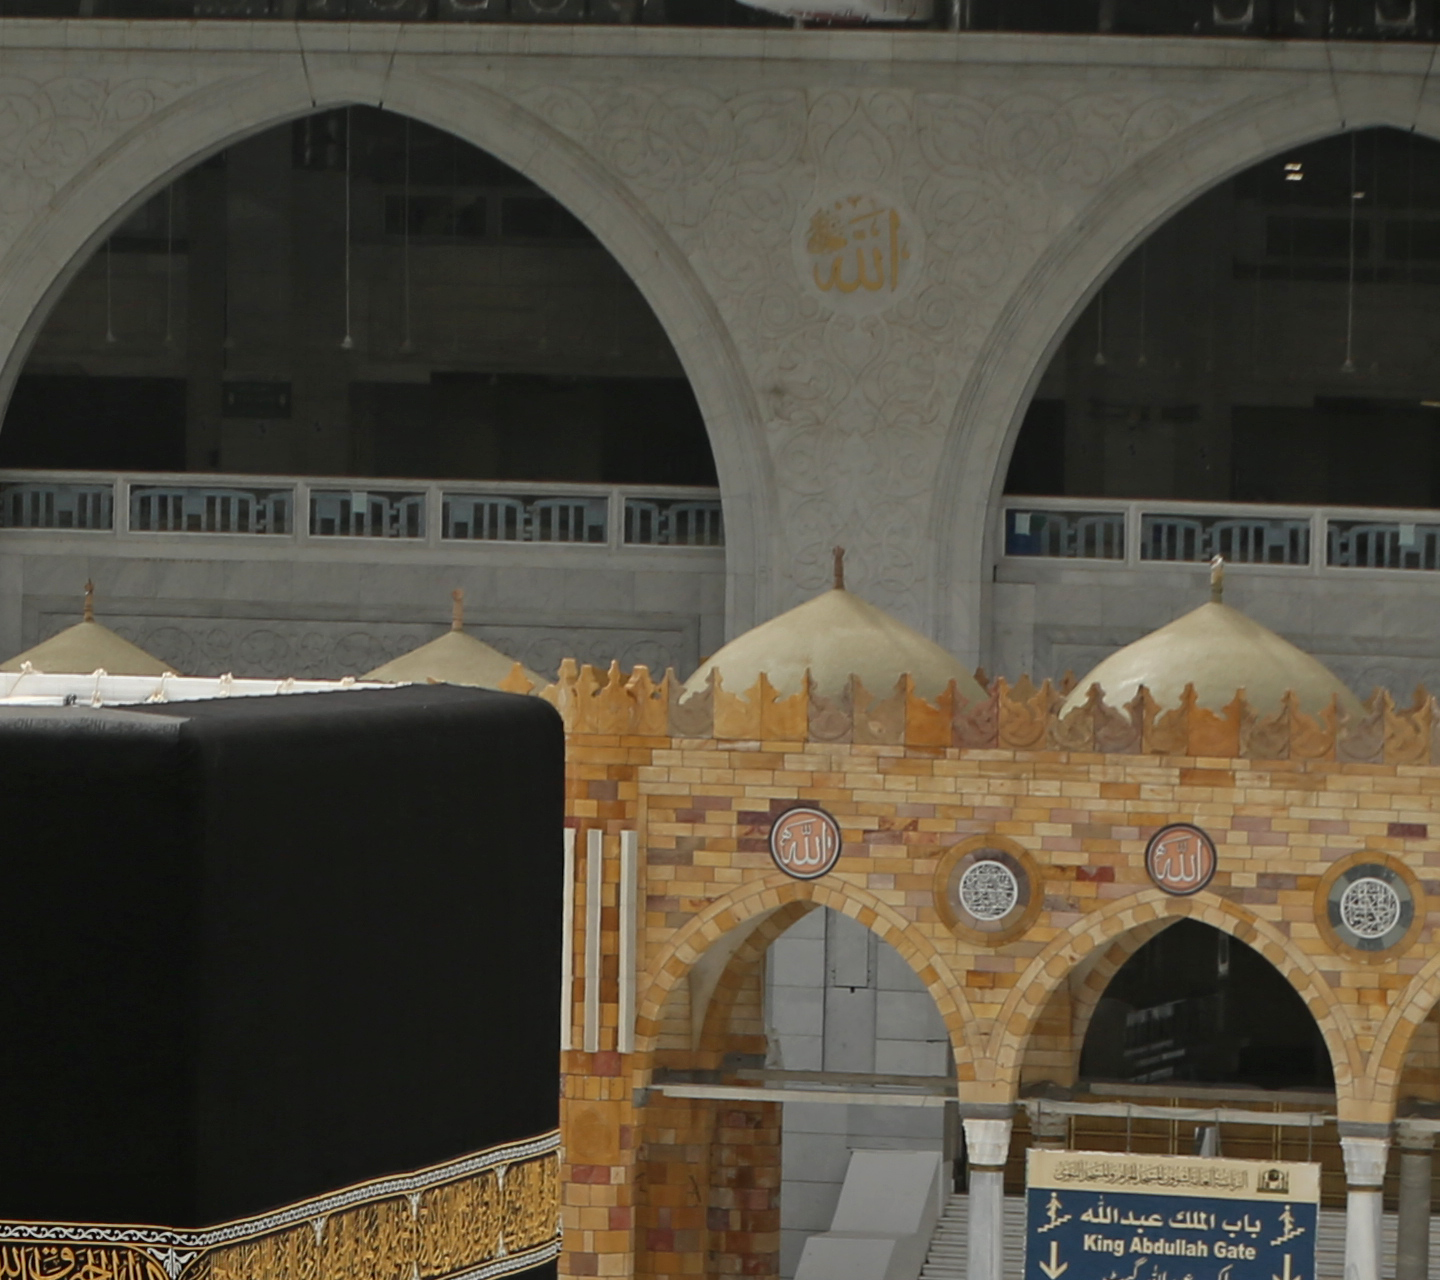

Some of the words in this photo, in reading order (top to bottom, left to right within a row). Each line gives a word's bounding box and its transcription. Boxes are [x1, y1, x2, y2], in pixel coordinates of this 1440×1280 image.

[1168, 1211, 1215, 1230] الملك
[1222, 1214, 1261, 1238] باب
[1084, 1234, 1125, 1257] King
[1130, 1236, 1208, 1257] Abdullah
[1214, 1241, 1256, 1260] Gate
